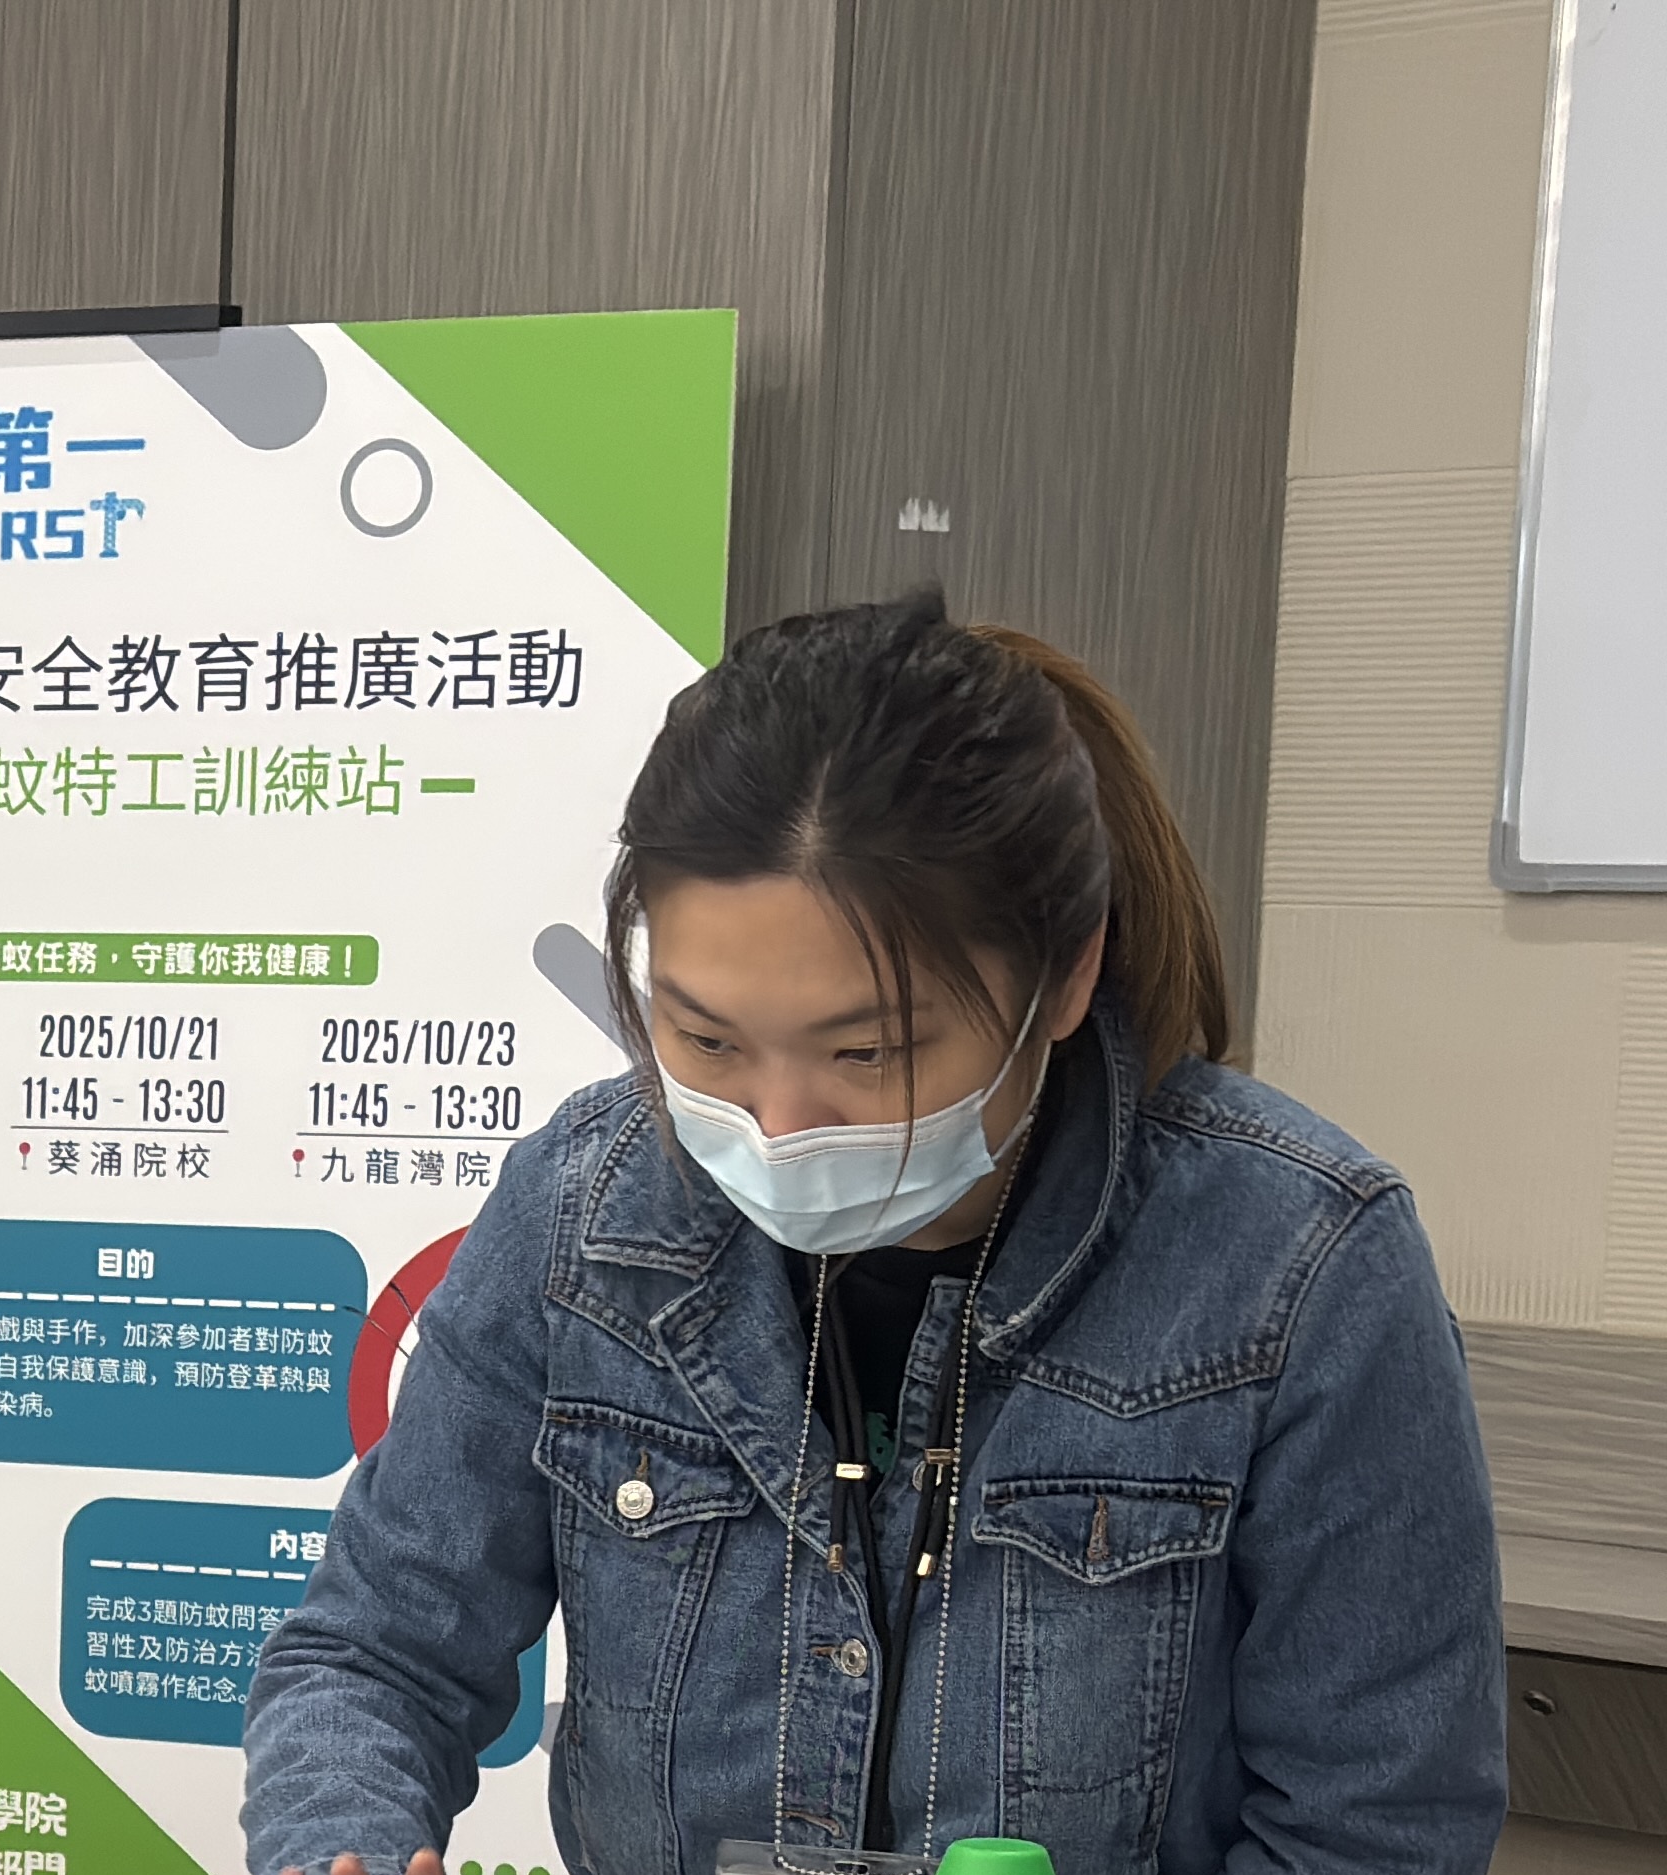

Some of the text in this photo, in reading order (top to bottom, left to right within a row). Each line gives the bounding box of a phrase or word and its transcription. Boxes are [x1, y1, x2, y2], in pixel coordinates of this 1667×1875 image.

[38, 1014, 218, 1061] 2025/10/21
[322, 1018, 516, 1067] 2025/10/23
[21, 1077, 98, 1121] 11:45
[138, 1079, 226, 1124] 13:30
[308, 1082, 389, 1128] 11:45
[431, 1084, 522, 1131] 13:30
[46, 1139, 211, 1180] 葵涌院校
[319, 1147, 492, 1187] 九龍灣院
[98, 1248, 155, 1280] 目的
[270, 1529, 328, 1561] 內容
[85, 1594, 295, 1632] 完成3題防蚊問答
[84, 1666, 247, 1705] 蚊噴霧作紀念。
